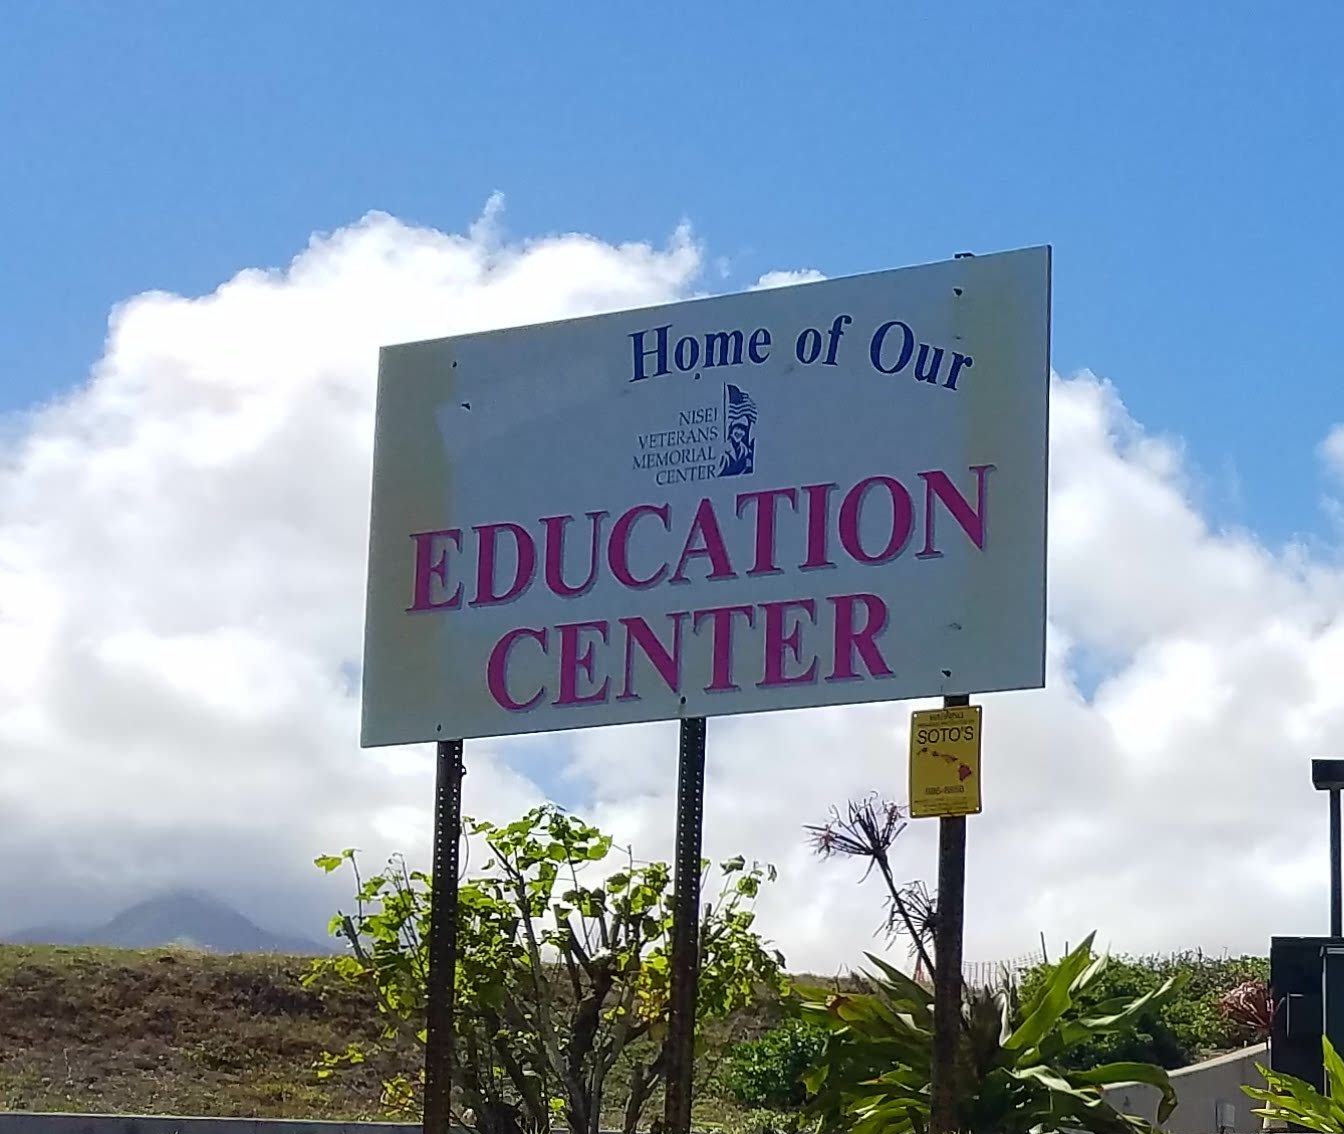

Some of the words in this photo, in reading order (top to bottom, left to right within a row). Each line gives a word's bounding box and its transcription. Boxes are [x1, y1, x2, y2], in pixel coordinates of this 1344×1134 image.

[628, 324, 772, 383] Home
[795, 314, 852, 366] of
[869, 320, 974, 391] Our
[679, 407, 718, 426] NISEI
[638, 426, 719, 450] VETERANS
[632, 446, 717, 470] MEMORIAL
[656, 464, 717, 486] CENTER
[406, 464, 997, 614] EDUCATION
[486, 593, 896, 712] CENTER
[917, 725, 974, 745] SOTO'S
